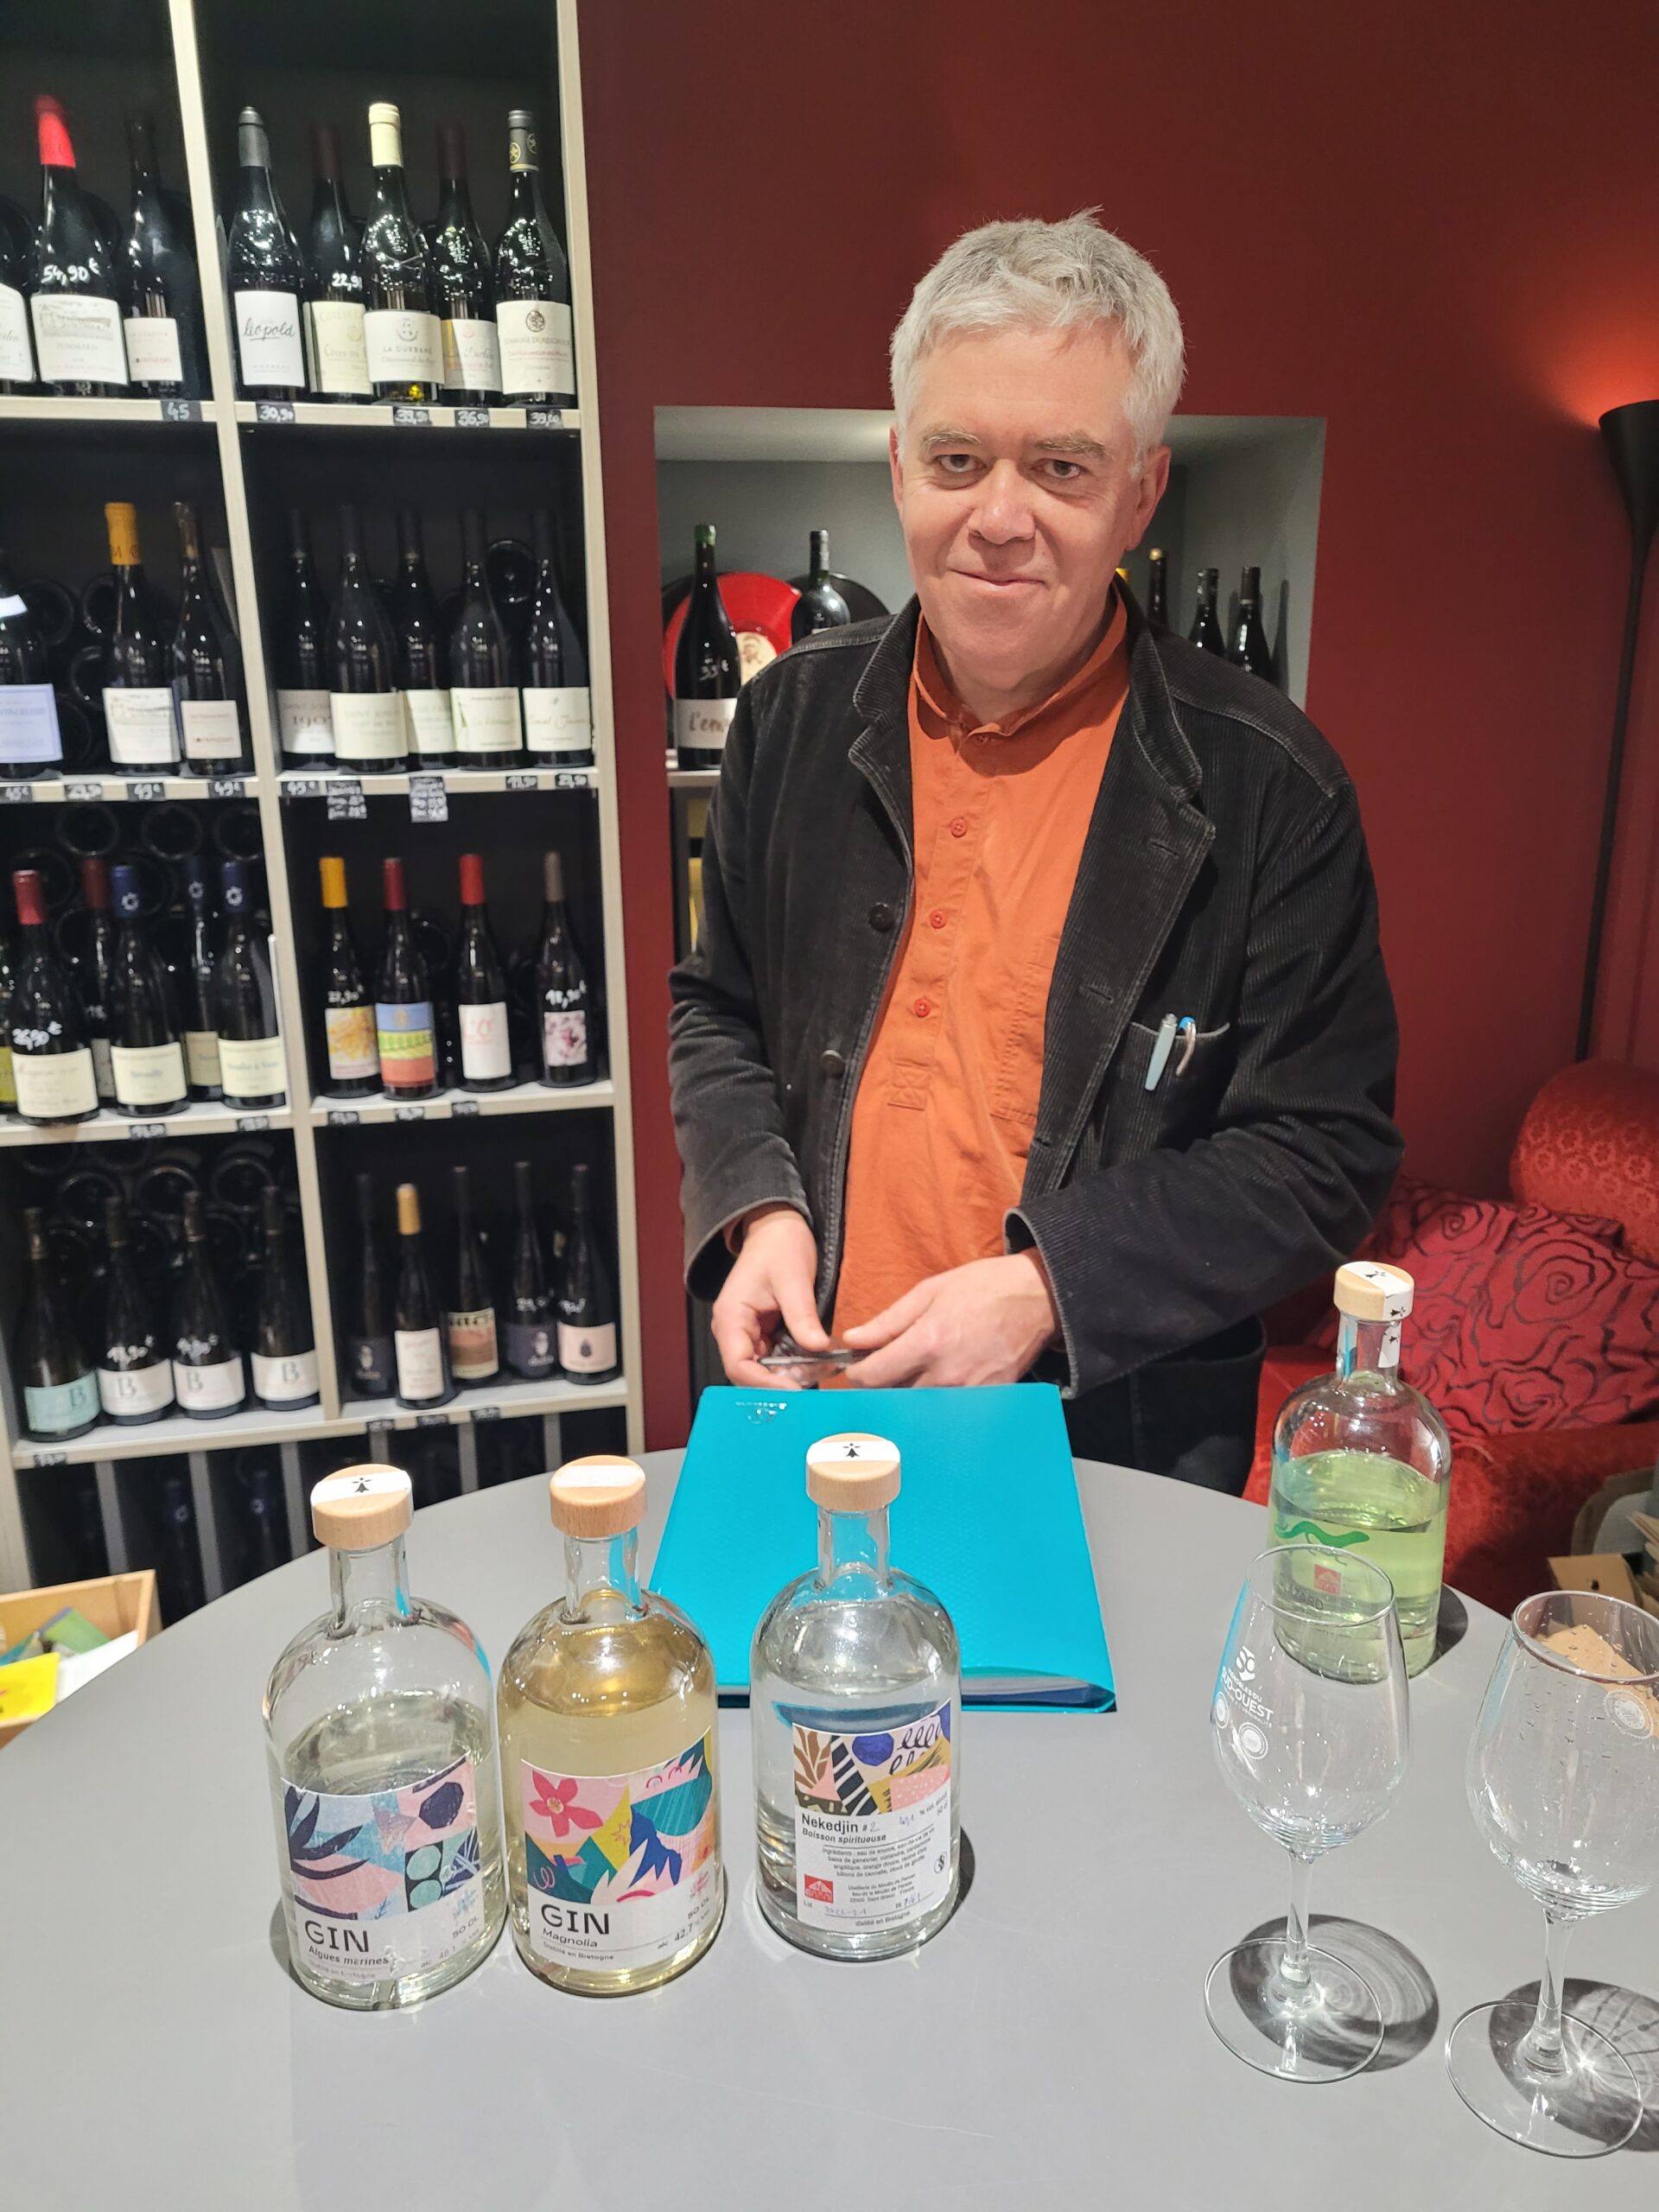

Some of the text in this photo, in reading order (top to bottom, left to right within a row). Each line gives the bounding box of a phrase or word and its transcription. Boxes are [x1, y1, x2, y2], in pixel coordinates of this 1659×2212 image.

[332, 273, 363, 291] 22,9
[167, 402, 190, 422] 45
[118, 1376, 137, 1398] B
[186, 1370, 205, 1392] B
[69, 1385, 85, 1409] B
[801, 1812, 859, 1835] Nekedjin
[802, 1827, 887, 1846] Boisson spiritueuse
[541, 1903, 610, 1936] GIN
[304, 1919, 370, 1954] GIN
[543, 1926, 599, 1948] Magnolia
[308, 1944, 389, 1967] Algues marines
